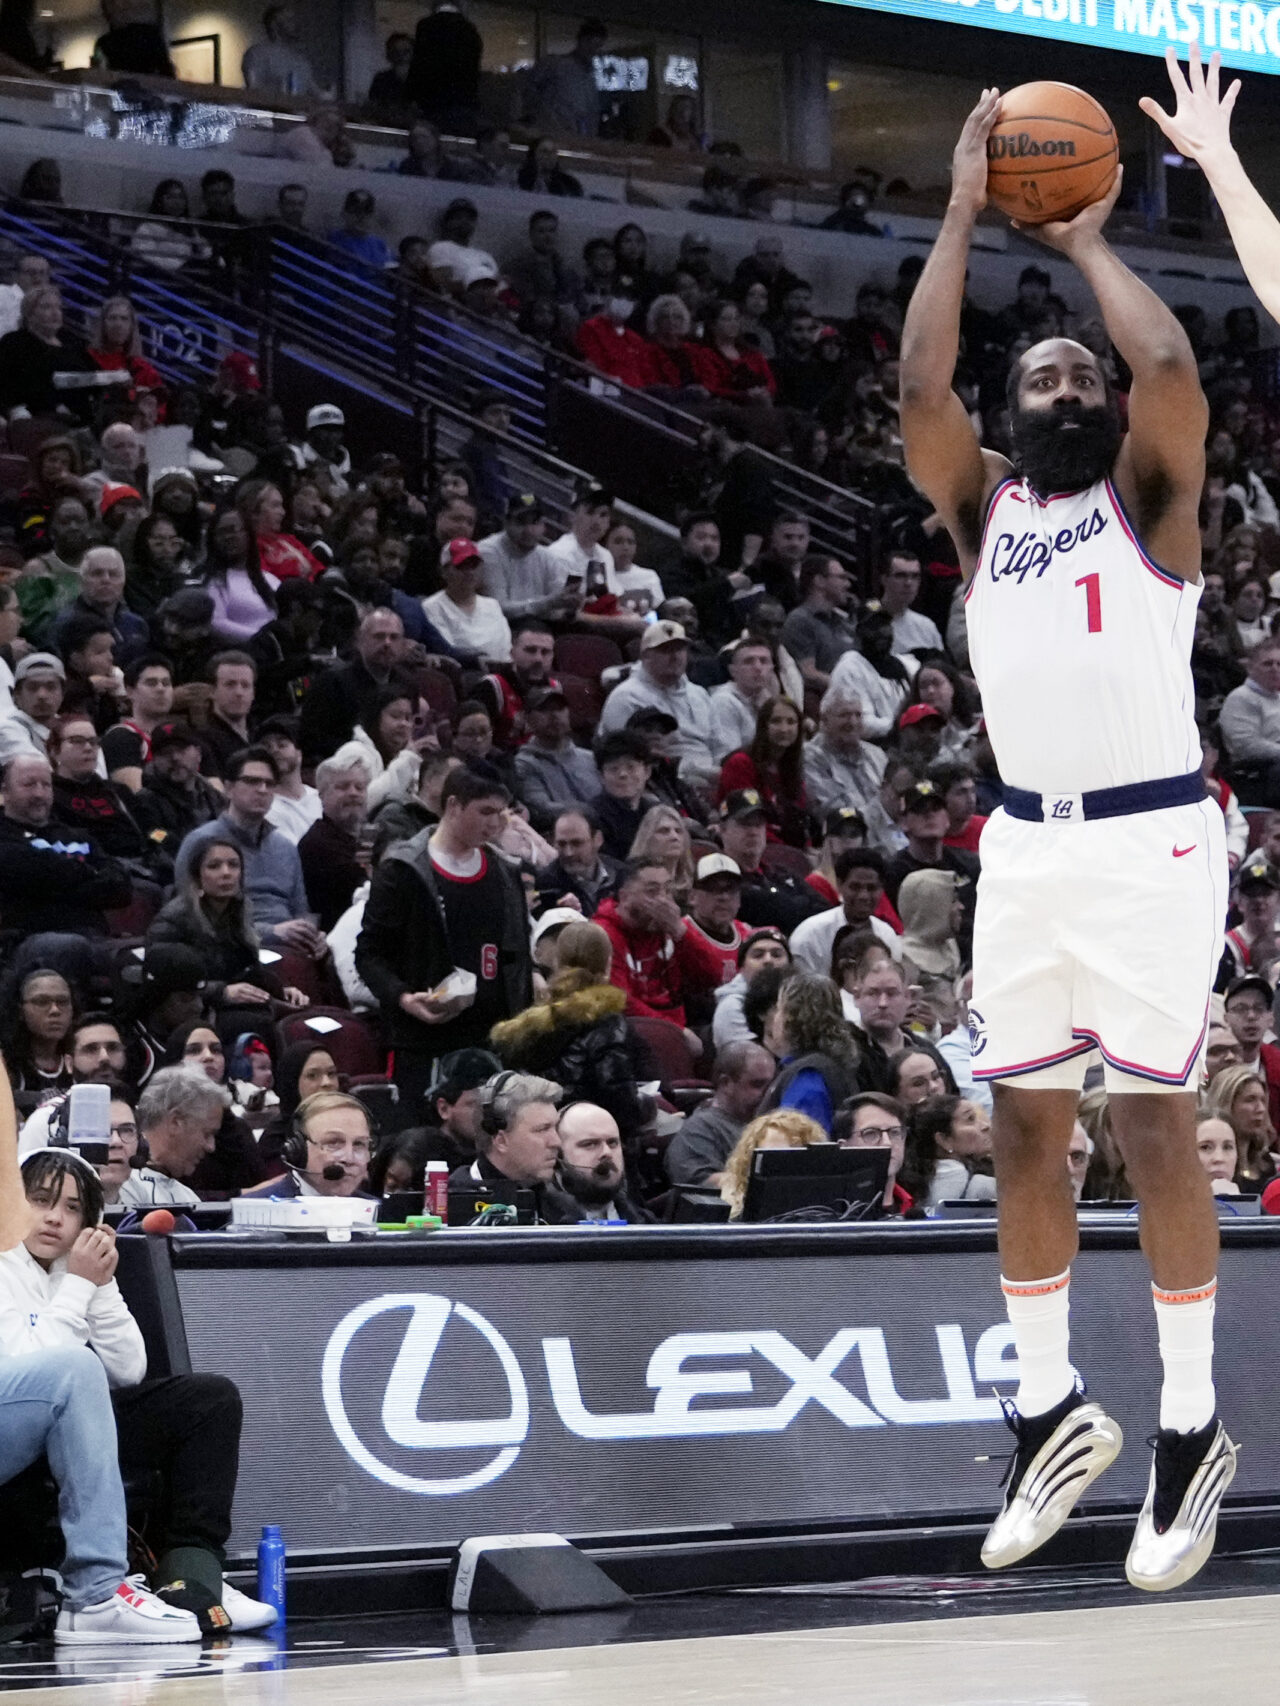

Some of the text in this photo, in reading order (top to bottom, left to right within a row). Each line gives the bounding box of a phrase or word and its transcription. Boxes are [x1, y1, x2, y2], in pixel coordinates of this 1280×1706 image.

[987, 132, 1076, 160] Wilson
[990, 508, 1108, 584] Clippers
[1075, 573, 1102, 633] 1
[1051, 799, 1073, 819] LA
[481, 943, 498, 979] 6
